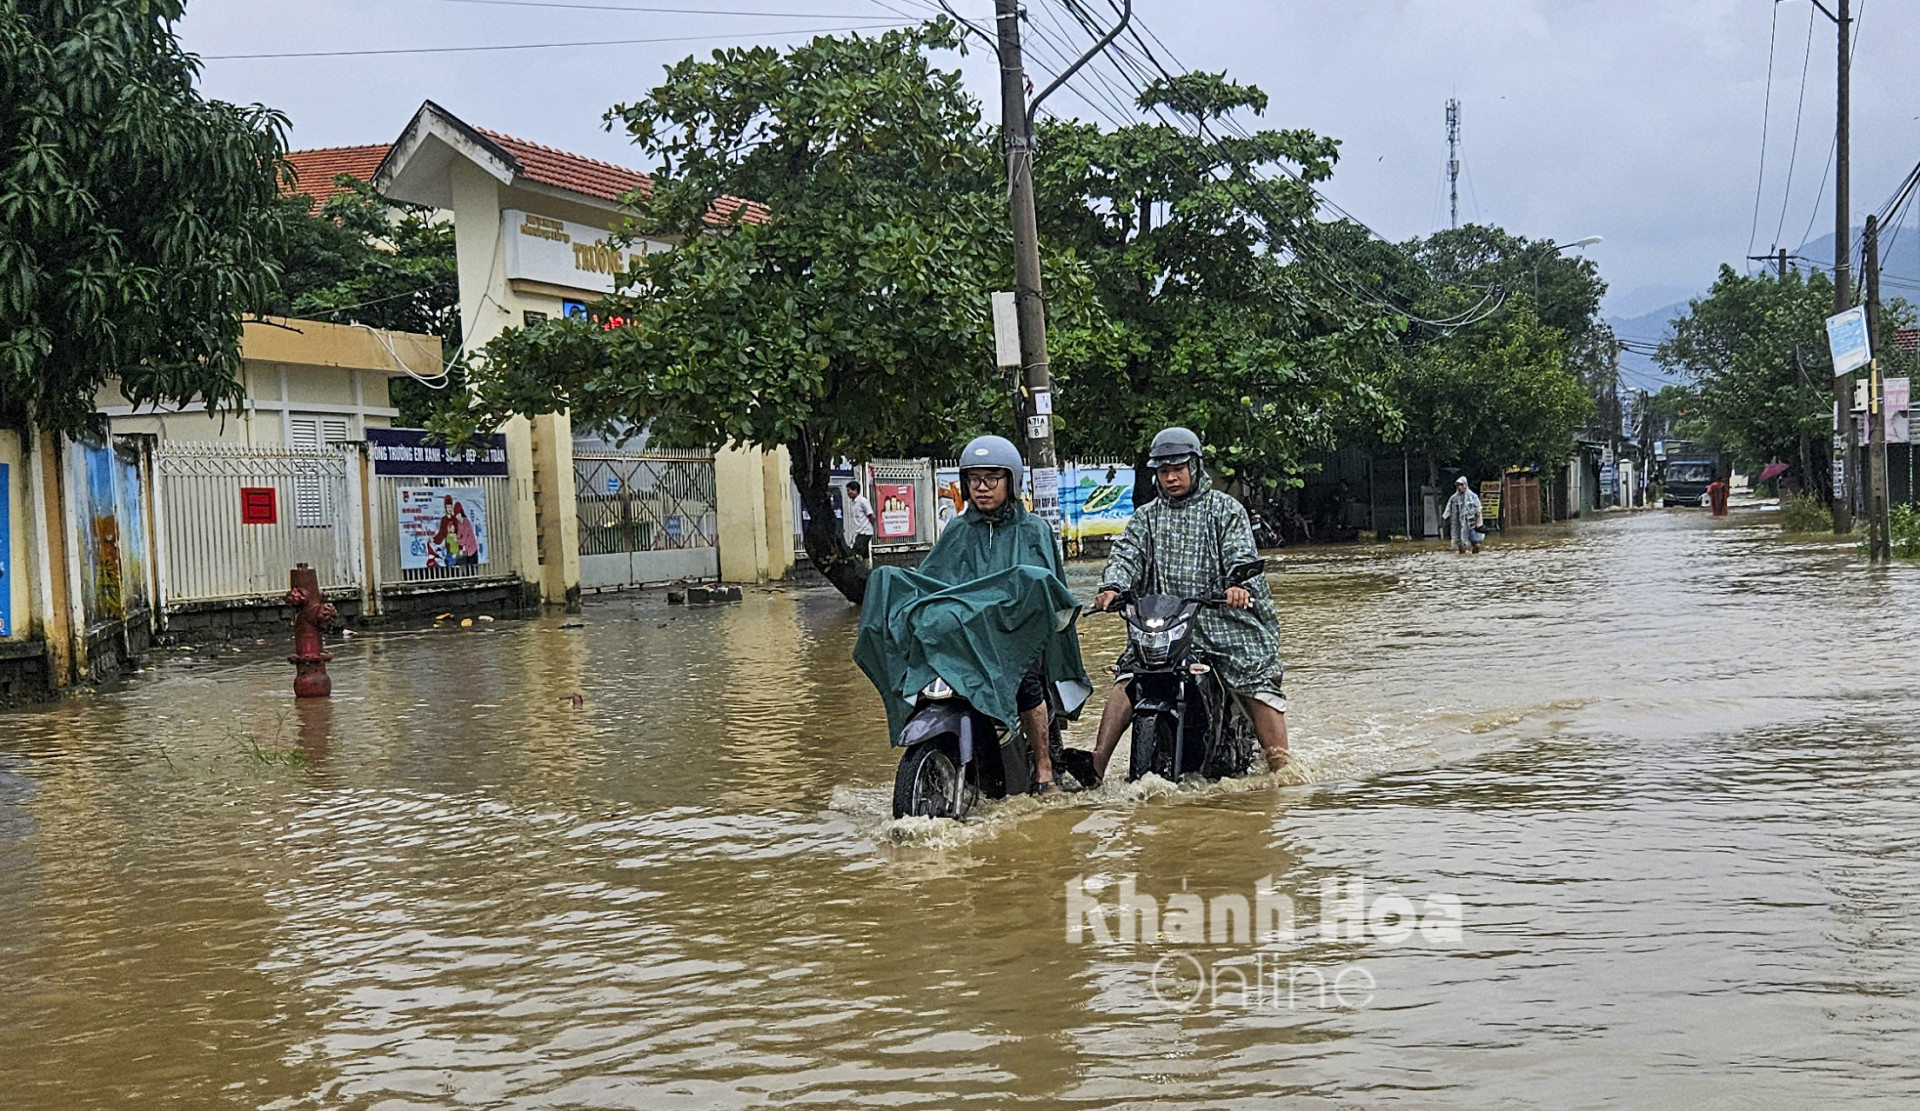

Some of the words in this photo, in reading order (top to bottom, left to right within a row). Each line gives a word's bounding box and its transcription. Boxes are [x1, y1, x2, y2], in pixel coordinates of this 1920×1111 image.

[374, 440, 387, 461] ỔNG
[388, 443, 413, 462] TRƯỜNG
[424, 447, 442, 462] XANH
